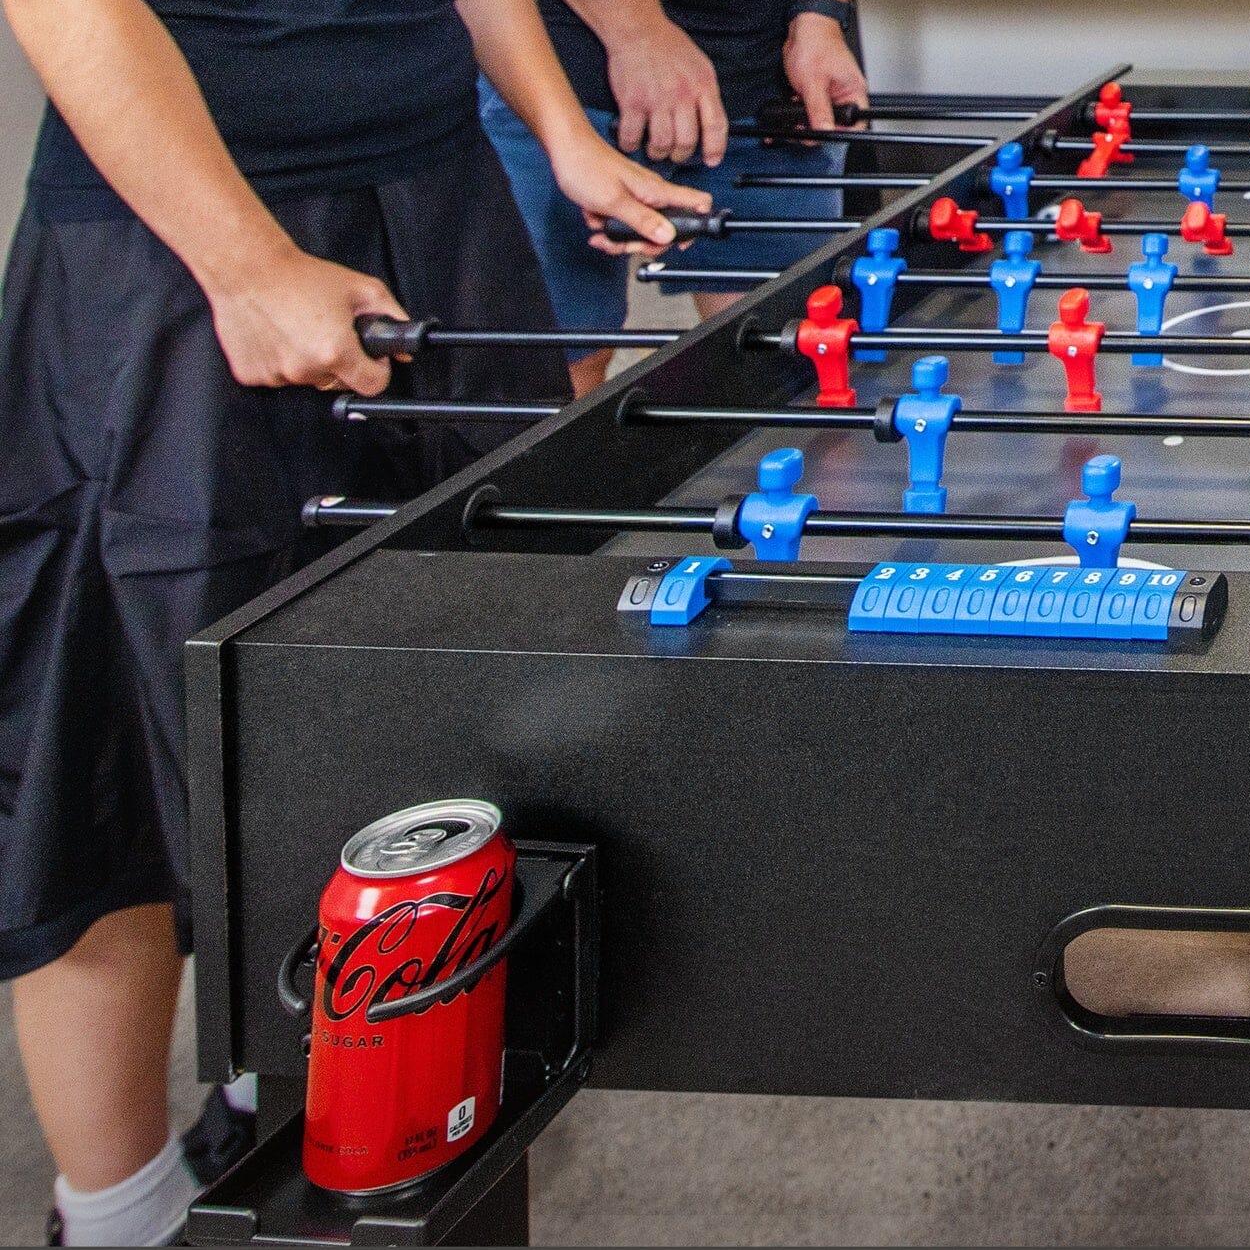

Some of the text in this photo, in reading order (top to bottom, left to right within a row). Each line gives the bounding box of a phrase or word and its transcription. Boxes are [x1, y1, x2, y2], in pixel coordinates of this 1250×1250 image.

[684, 561, 1178, 587] 1 2 3 4 5 6 7 8 9 10
[322, 1030, 384, 1049] SUGAR
